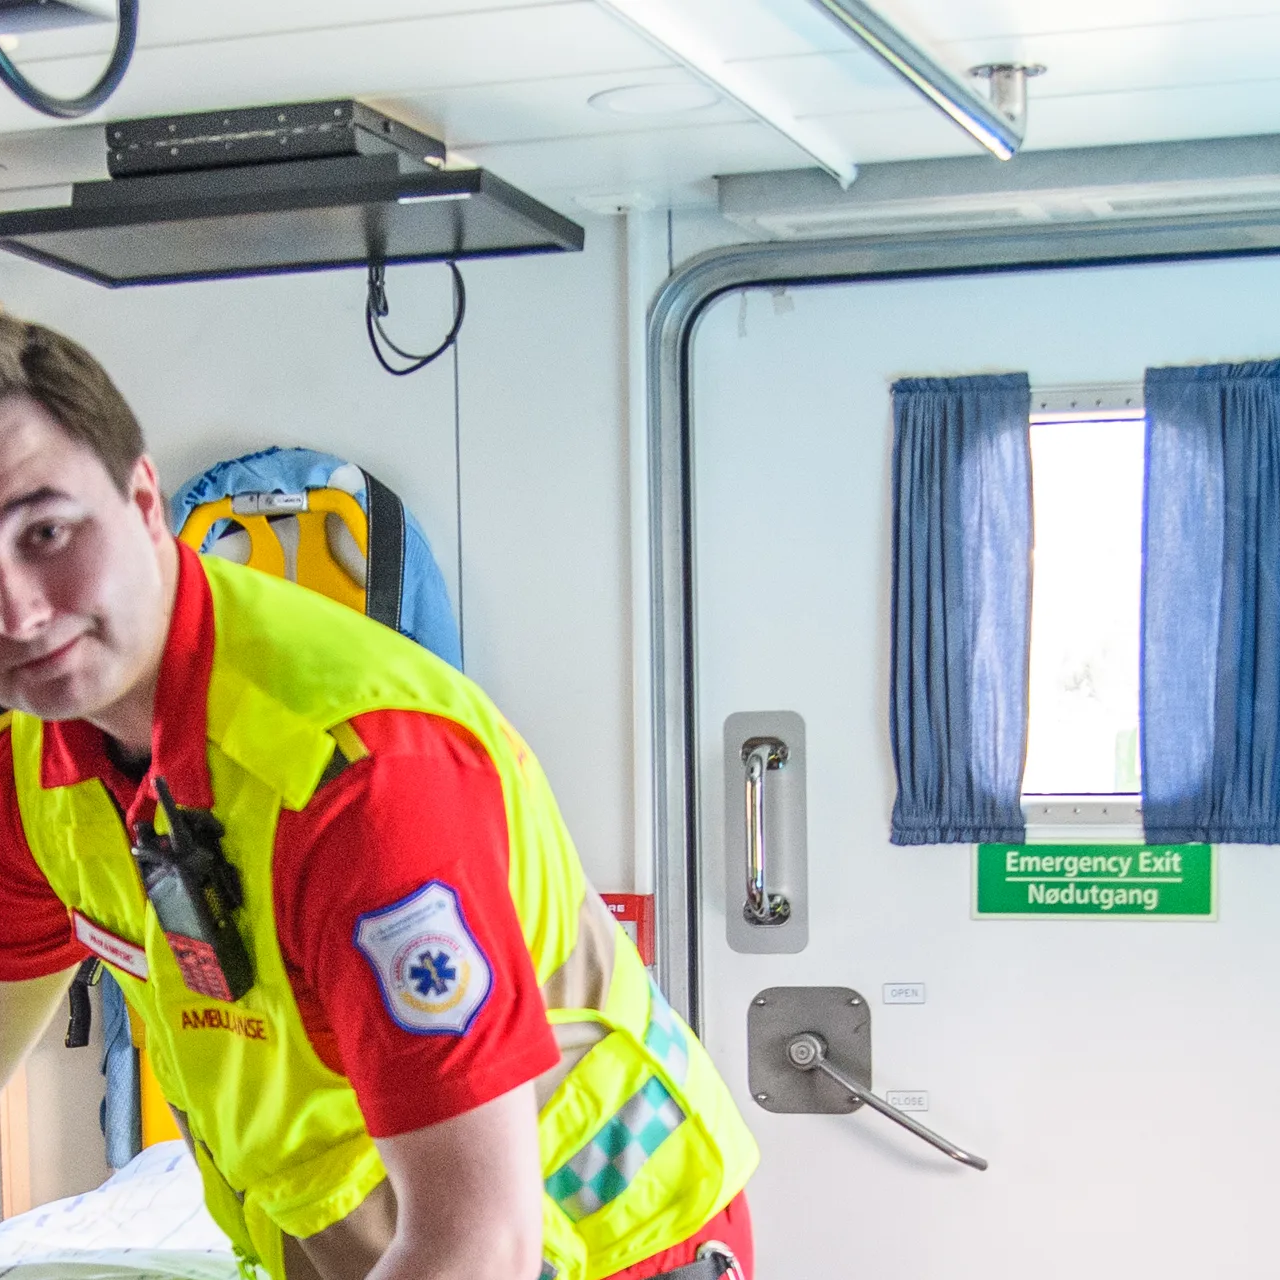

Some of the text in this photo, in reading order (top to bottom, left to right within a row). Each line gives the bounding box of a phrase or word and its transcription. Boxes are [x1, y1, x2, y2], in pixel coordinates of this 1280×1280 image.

[1005, 851, 1183, 877] Emergency Exit
[1027, 882, 1159, 910] Nødutgang
[608, 904, 626, 913] RE
[890, 988, 919, 998] OPEN
[891, 1096, 925, 1106] CLOSE
